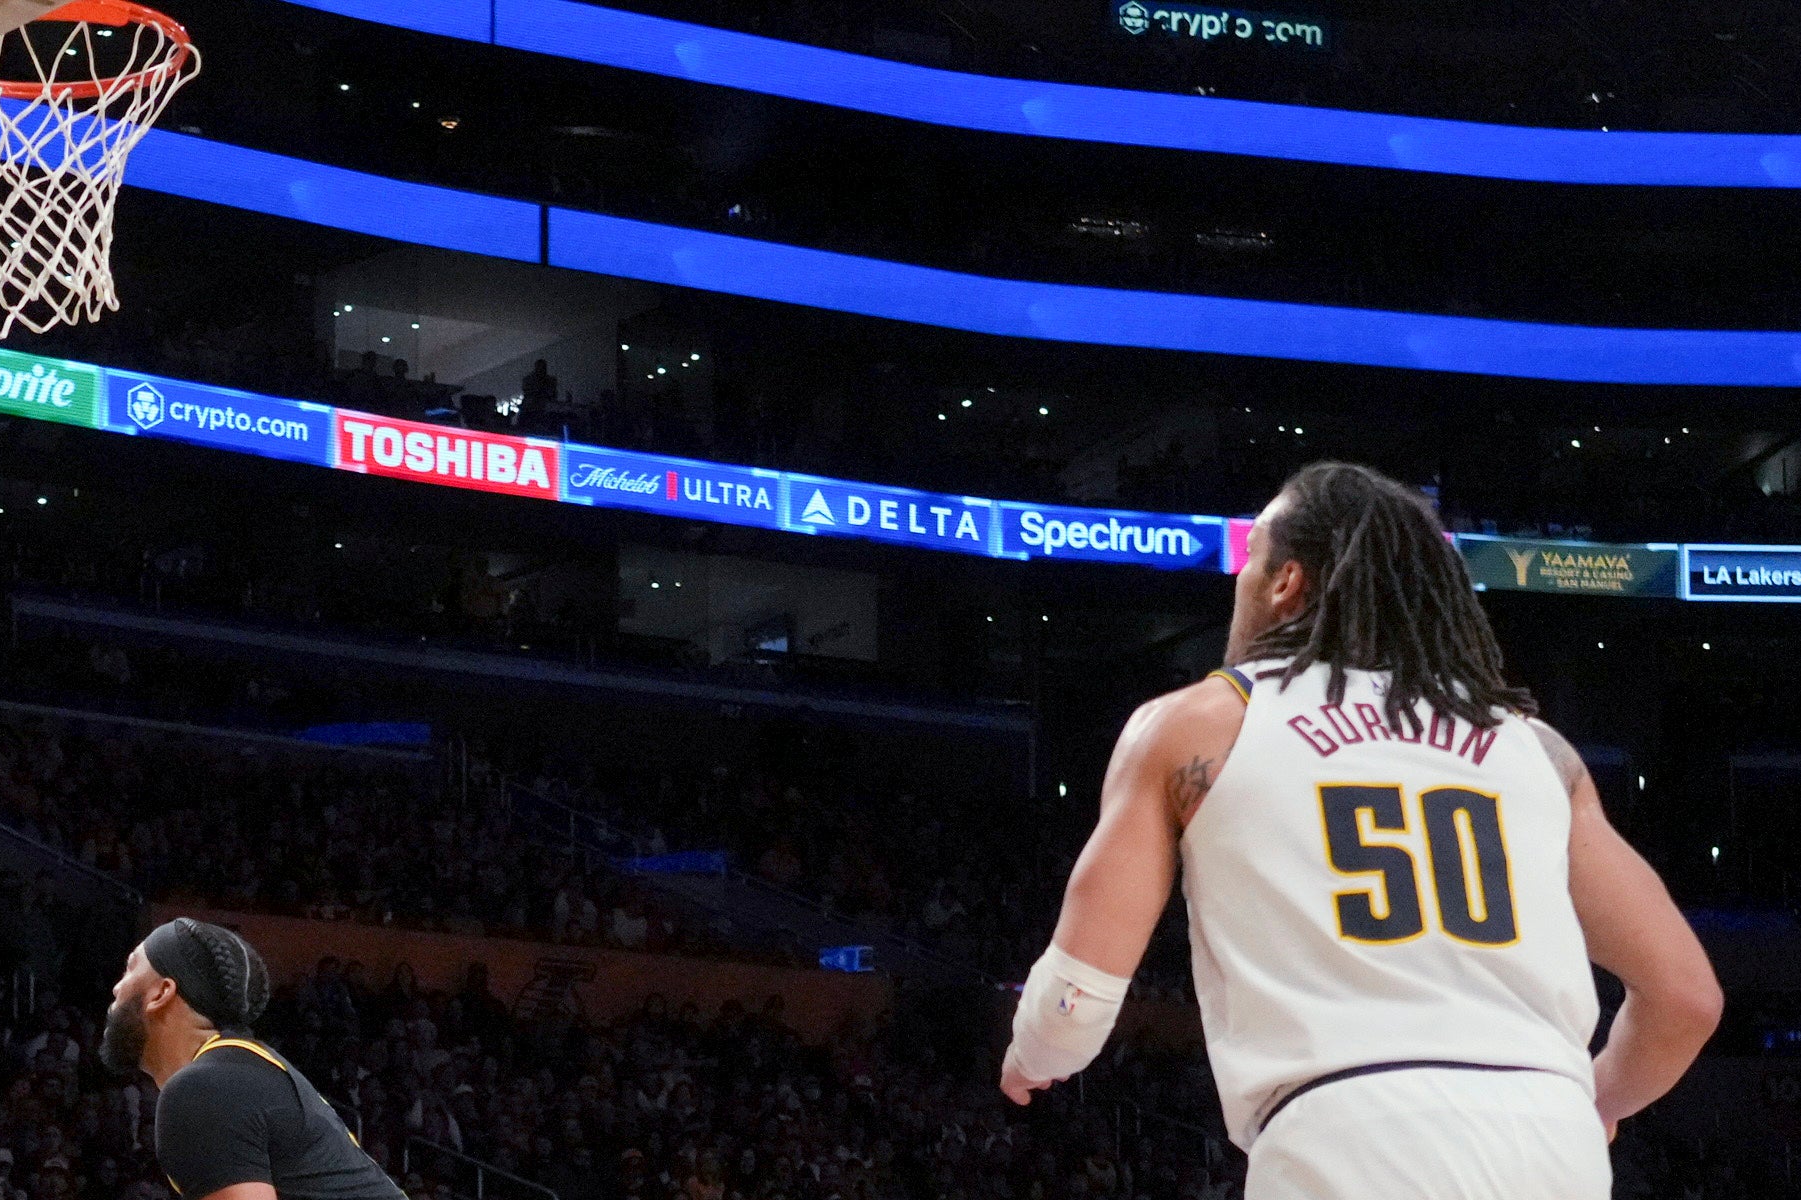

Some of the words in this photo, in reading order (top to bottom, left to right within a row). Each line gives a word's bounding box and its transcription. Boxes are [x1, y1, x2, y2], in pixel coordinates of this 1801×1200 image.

[1153, 10, 1323, 46] cryptocom
[169, 397, 308, 442] crypto.com
[343, 420, 550, 489] TOSHIBA
[570, 462, 663, 496] Michelob
[683, 477, 774, 511] ULTRA
[847, 495, 980, 541] DELTA
[1019, 511, 1192, 556] Spectrum
[1703, 565, 1732, 585] LA
[1736, 565, 1801, 586] Lakers
[1315, 781, 1521, 948] 50
